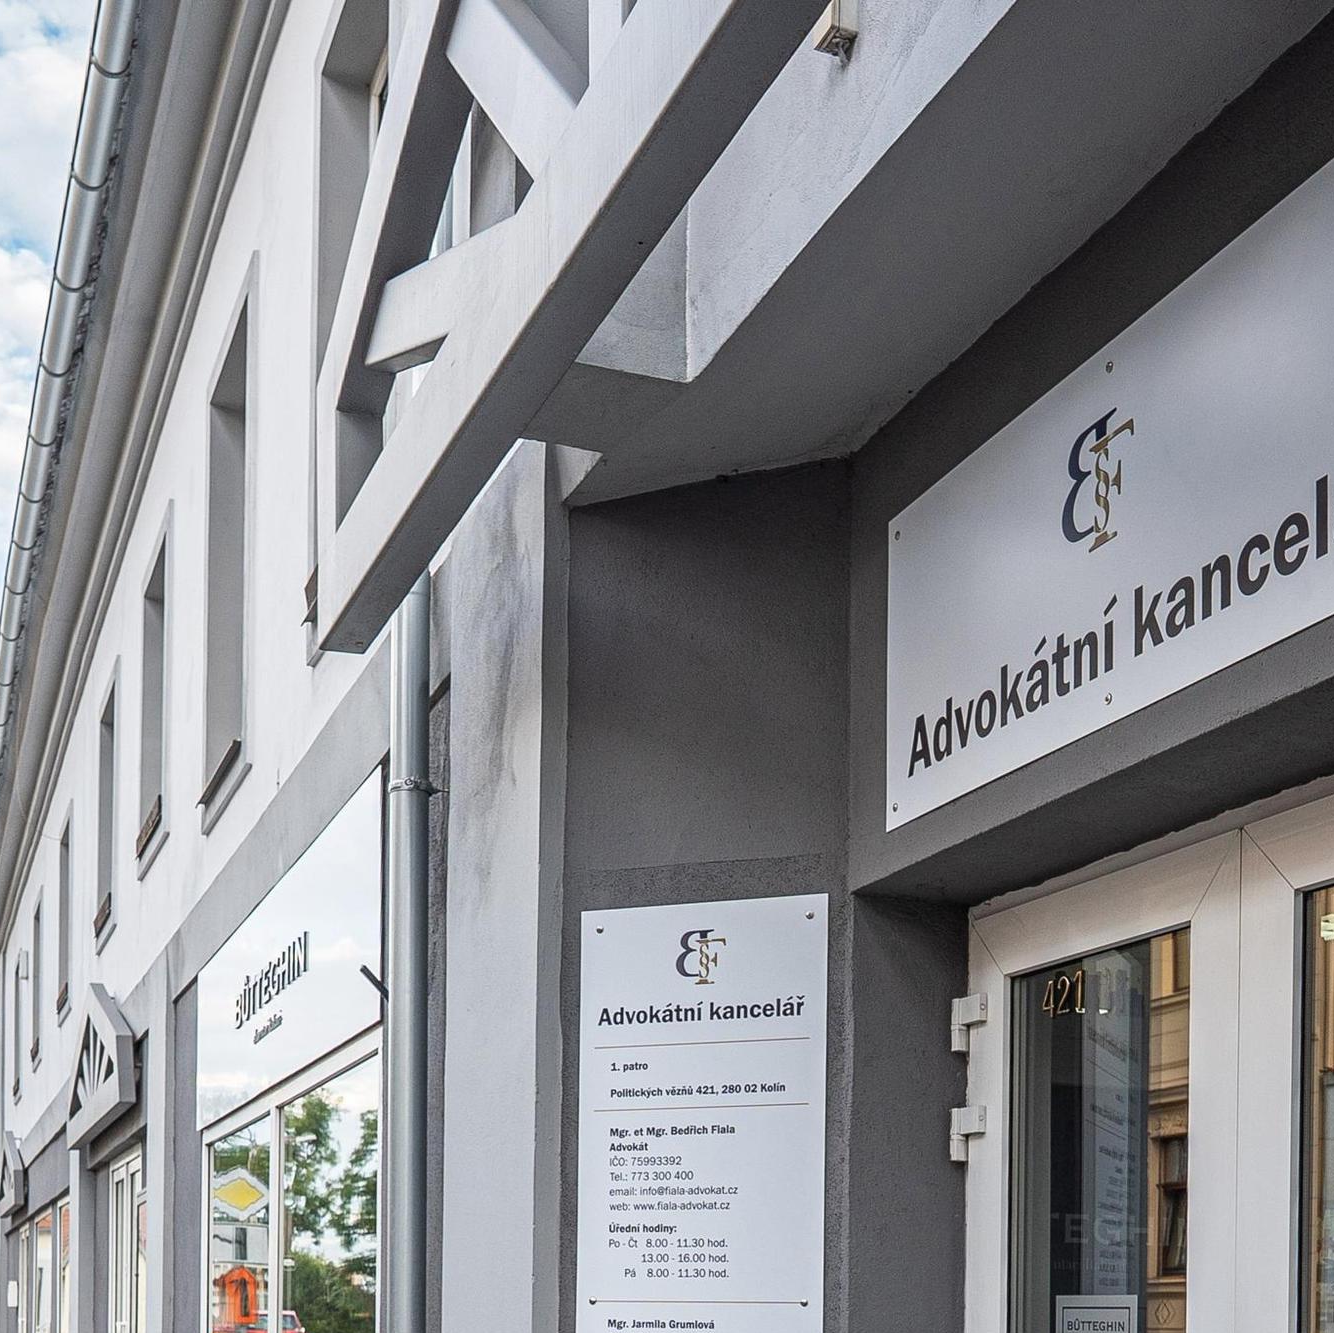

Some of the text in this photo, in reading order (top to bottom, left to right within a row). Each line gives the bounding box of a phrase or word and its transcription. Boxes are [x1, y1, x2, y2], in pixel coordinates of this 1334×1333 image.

[908, 595, 1115, 778] Advokátní
[1042, 969, 1086, 1018] 421
[598, 996, 805, 1026] Advokátní kancelář
[611, 1062, 648, 1072] 1. patro
[611, 1082, 785, 1098] Politických vězňů 421, 280 02 Kolín
[610, 1125, 735, 1138] Mgr. et Mgr. Bedřich Fiala
[610, 1142, 648, 1151] Advokát
[610, 1156, 681, 1166] IČO: 75993392
[611, 1171, 693, 1181] Tel.: 773 300 400
[610, 1186, 738, 1196] email: info@fiala-advokat.cz
[634, 1201, 729, 1210] www.fiala-advokat.cz
[609, 1224, 676, 1234] Úřední hodiny:
[609, 1239, 620, 1248] Po
[628, 1237, 637, 1248] Čt
[646, 1239, 668, 1248] 8.00
[677, 1238, 704, 1247] 11.30
[708, 1239, 727, 1247] hod.
[642, 1254, 669, 1262] 13.00
[679, 1253, 705, 1262] 16.00
[709, 1254, 728, 1262] hod.
[625, 1269, 636, 1277] Pá
[647, 1268, 669, 1277] 8.00
[679, 1269, 705, 1277] 11.30
[709, 1269, 729, 1278] hod.
[608, 1320, 714, 1329] Mgr. Jarmila Grumlová
